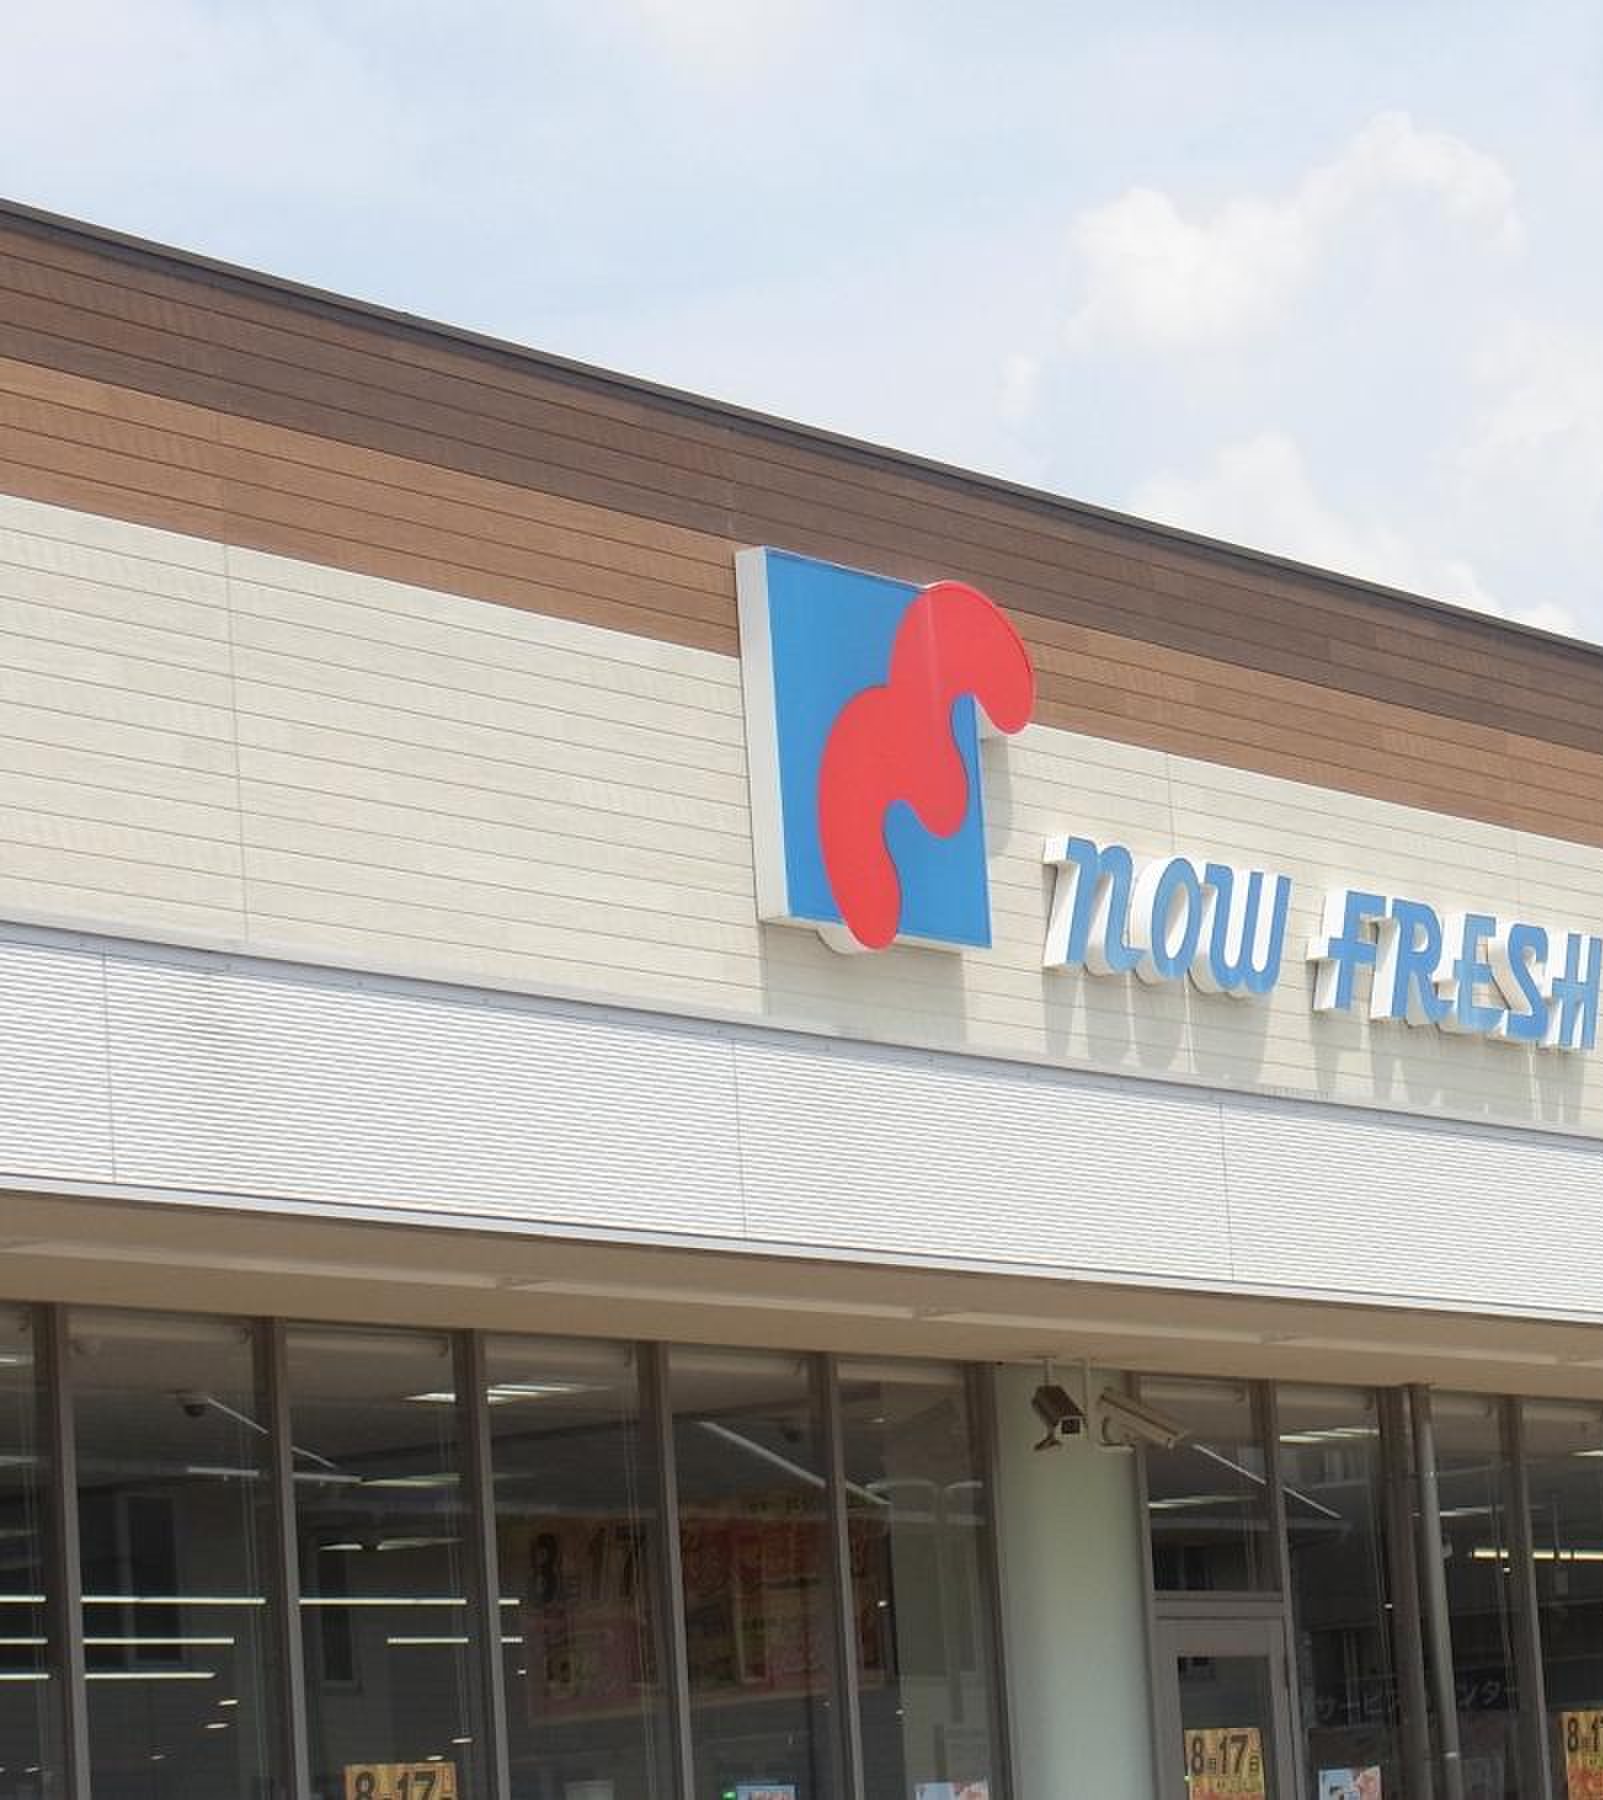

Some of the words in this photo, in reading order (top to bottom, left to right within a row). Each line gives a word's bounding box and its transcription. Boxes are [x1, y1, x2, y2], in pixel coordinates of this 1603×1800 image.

[1326, 889, 1603, 1051] FRESH
[1315, 1680, 1521, 1721] サービンター
[354, 1770, 453, 1800] 817
